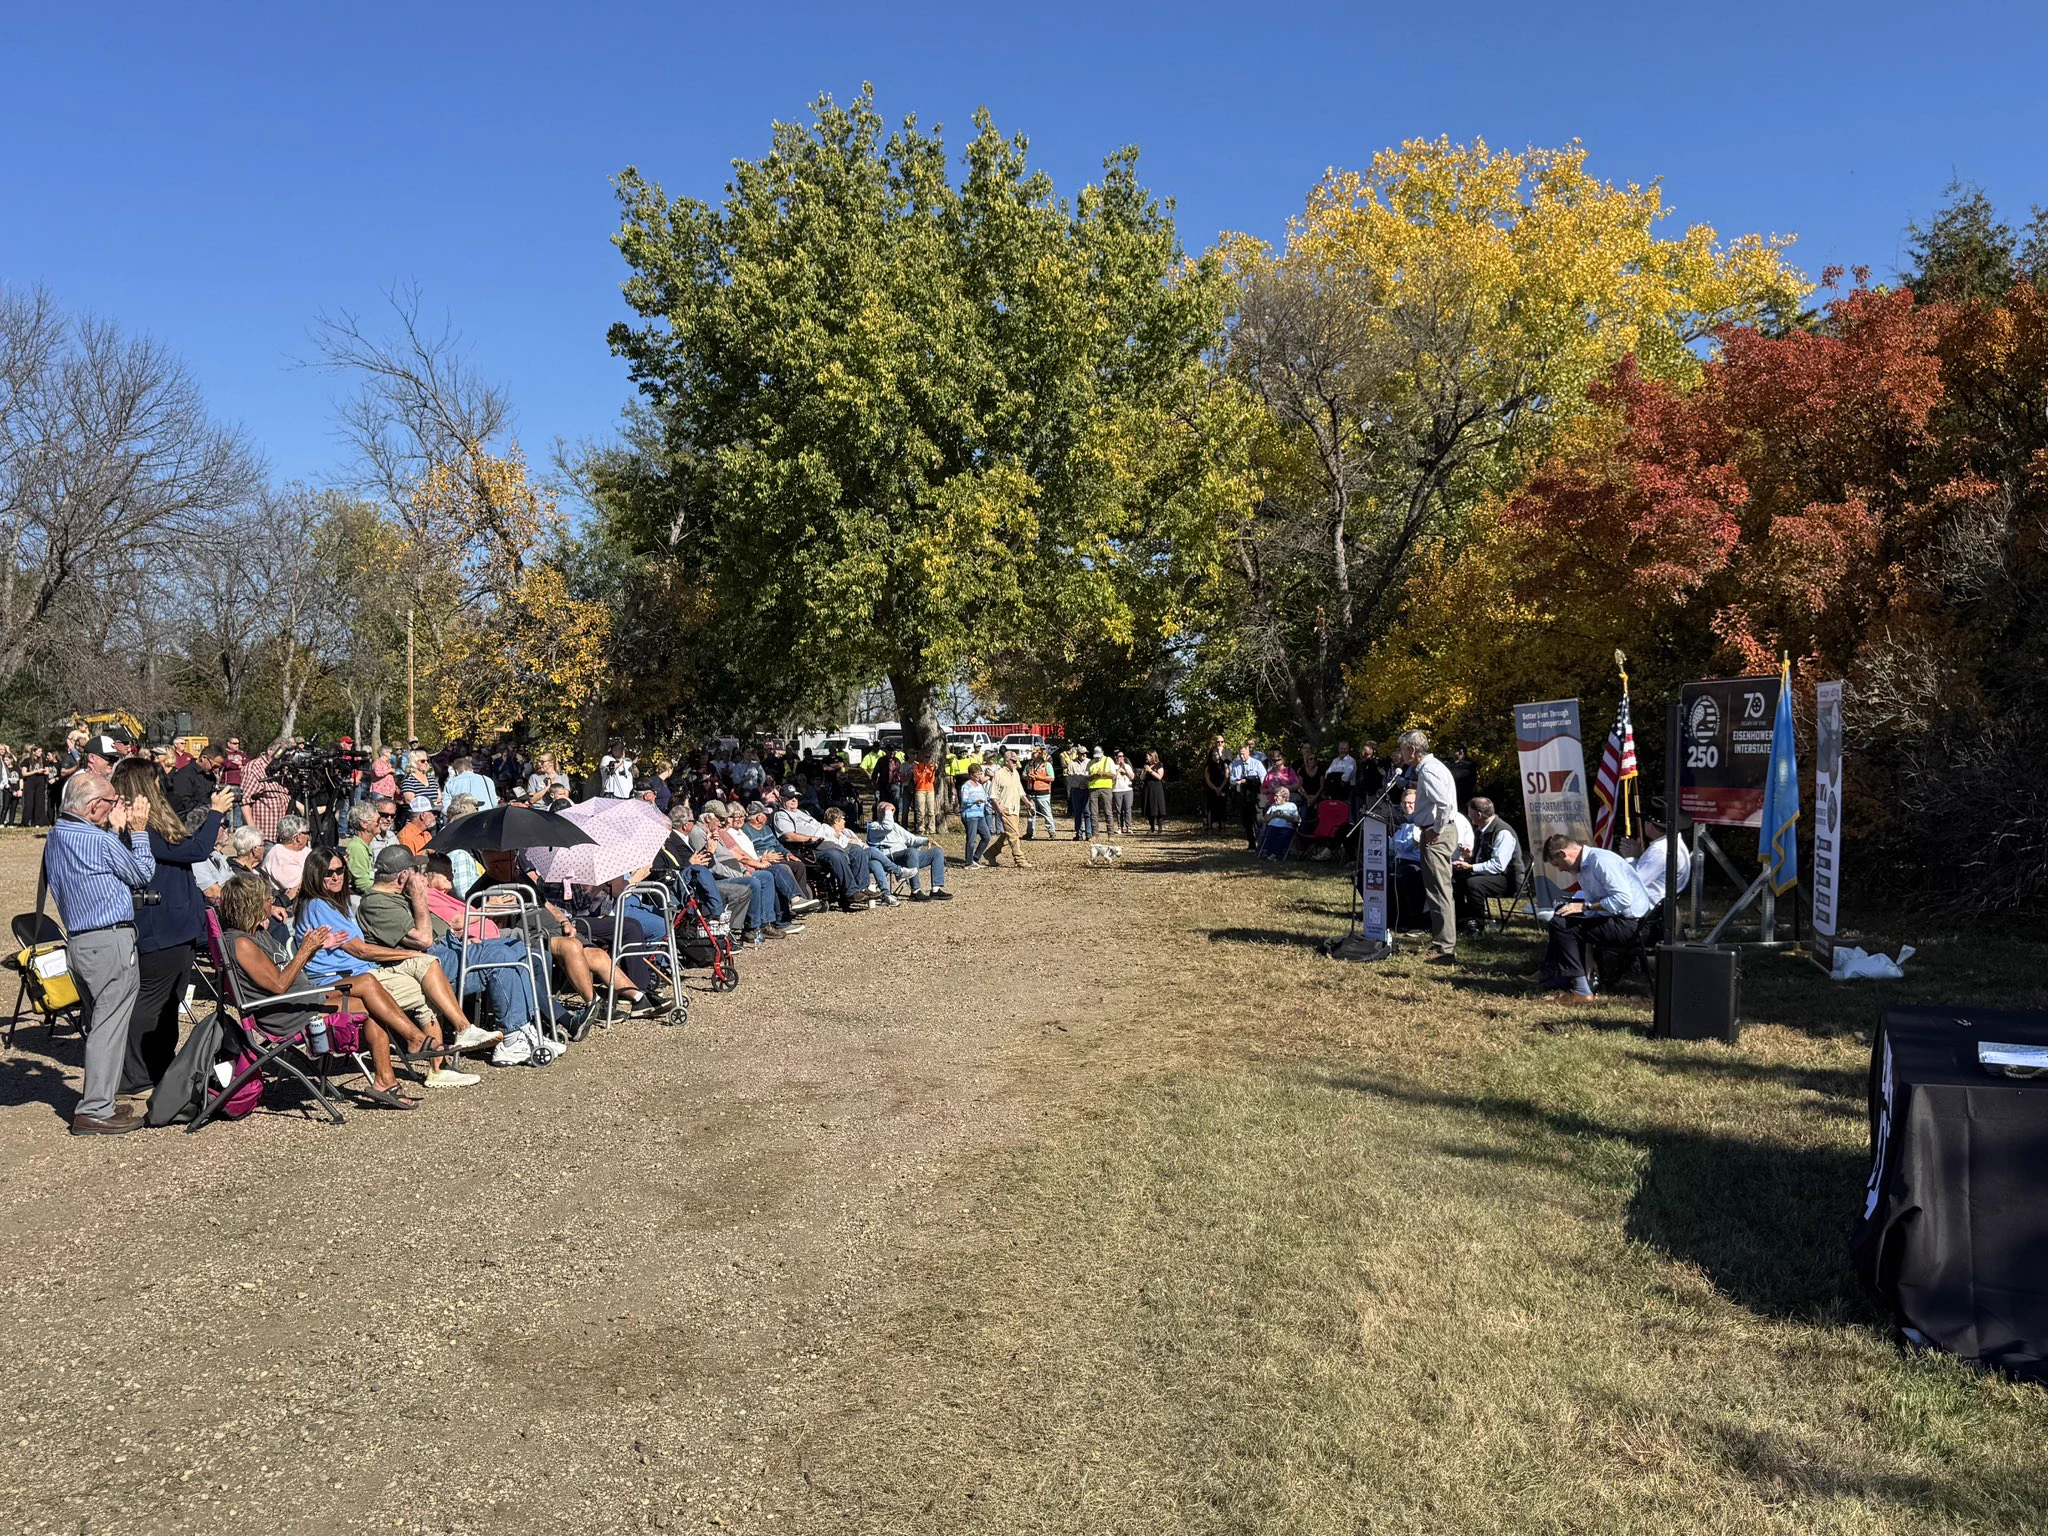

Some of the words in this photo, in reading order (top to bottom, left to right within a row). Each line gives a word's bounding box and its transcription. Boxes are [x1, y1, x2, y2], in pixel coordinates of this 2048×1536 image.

[1744, 692, 1765, 718] 70
[1537, 711, 1549, 719] Lives
[1549, 709, 1569, 719] Through
[1537, 720, 1572, 729] Transportation
[1733, 730, 1774, 741] EISENHOWER
[1734, 743, 1772, 754] INTERSTATE
[1687, 746, 1719, 768] 250
[1527, 771, 1547, 794] SD
[1529, 801, 1572, 812] DEPARTMENT
[1531, 813, 1585, 824] TRANSPORTATION
